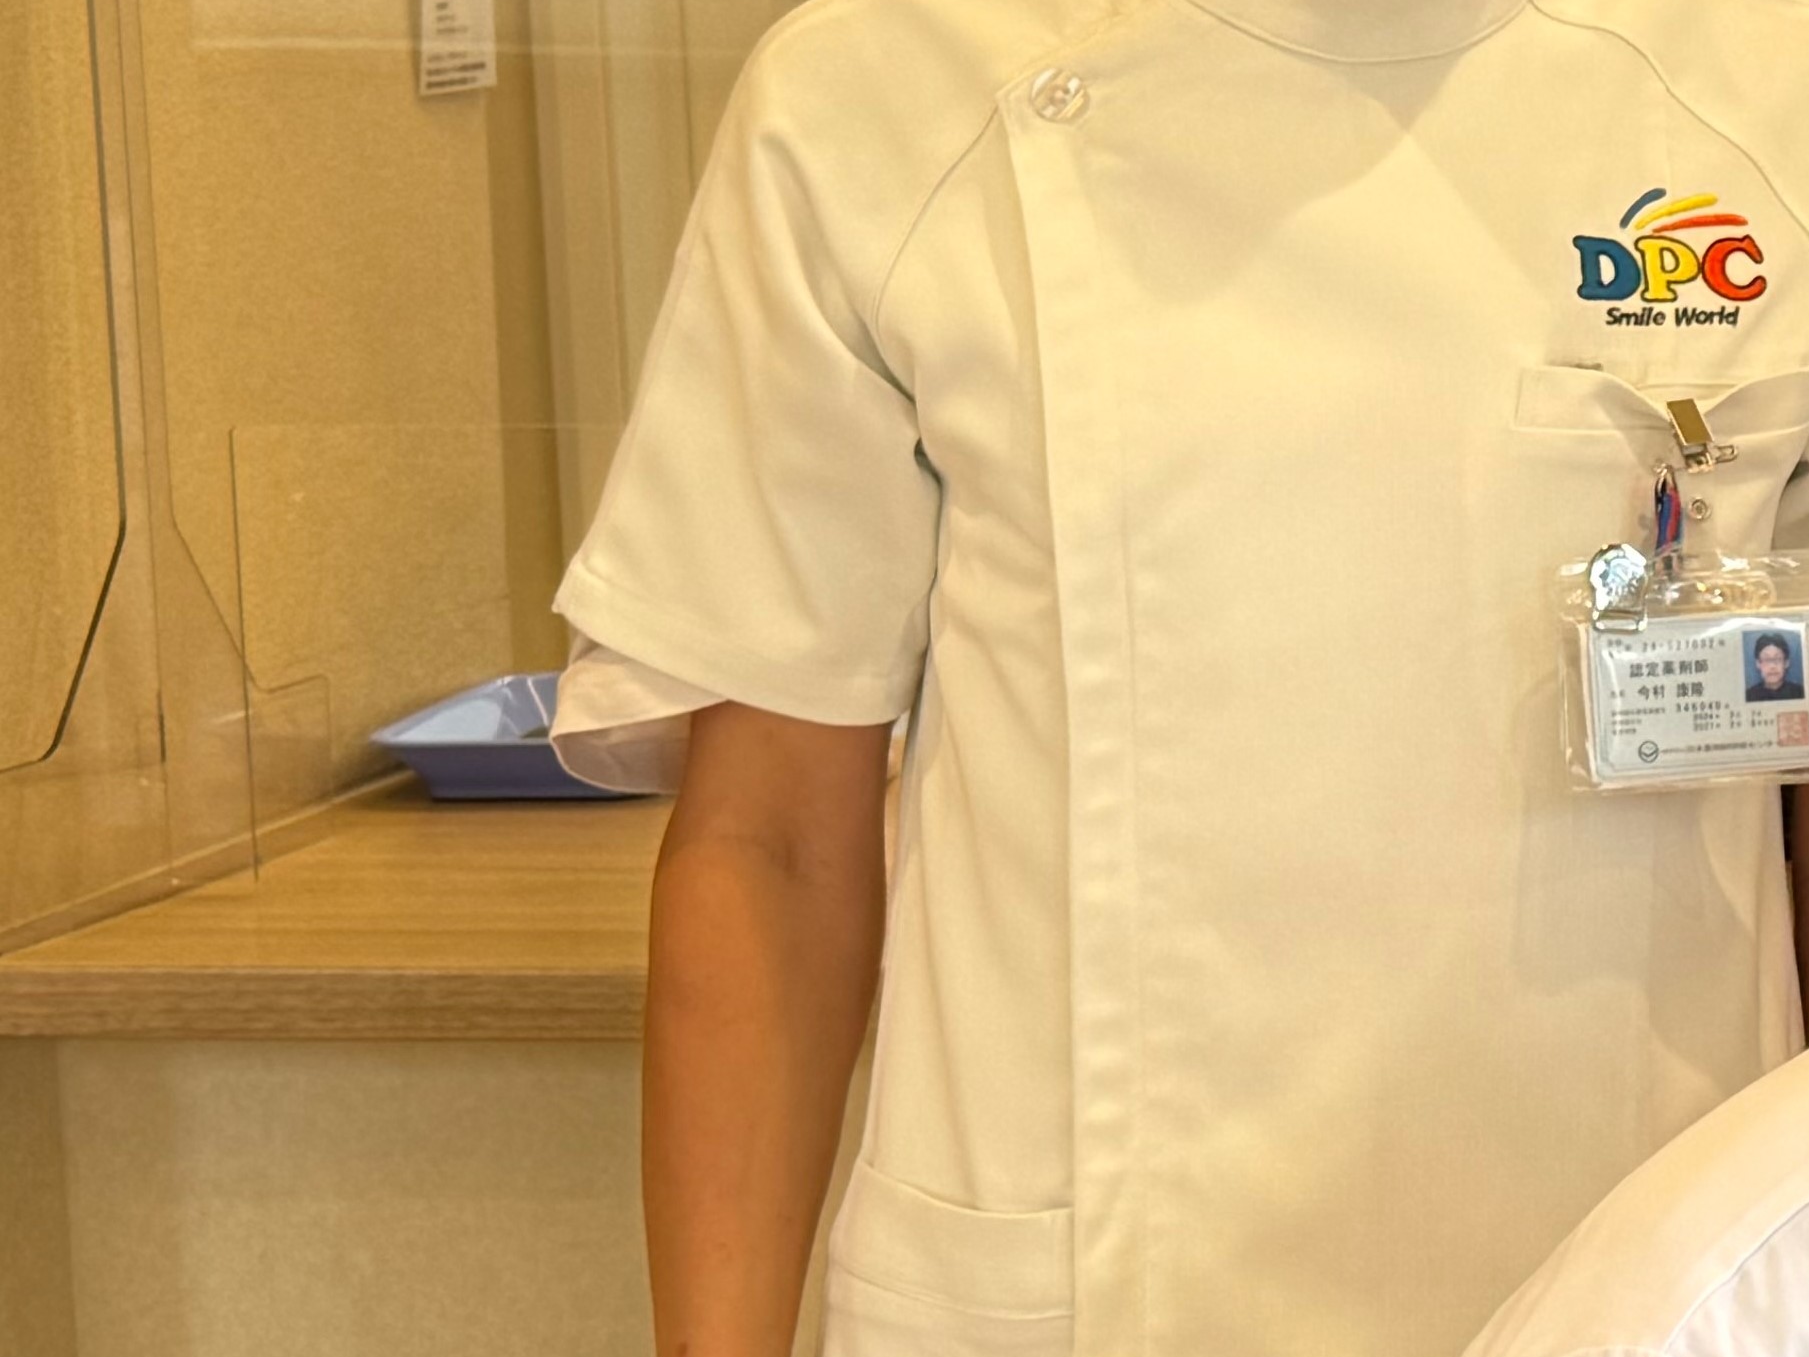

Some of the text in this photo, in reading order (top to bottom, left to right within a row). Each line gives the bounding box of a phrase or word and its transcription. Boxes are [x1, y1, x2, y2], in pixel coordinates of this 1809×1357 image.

[1572, 233, 1767, 303] DPC
[1605, 305, 1741, 328] Smile World
